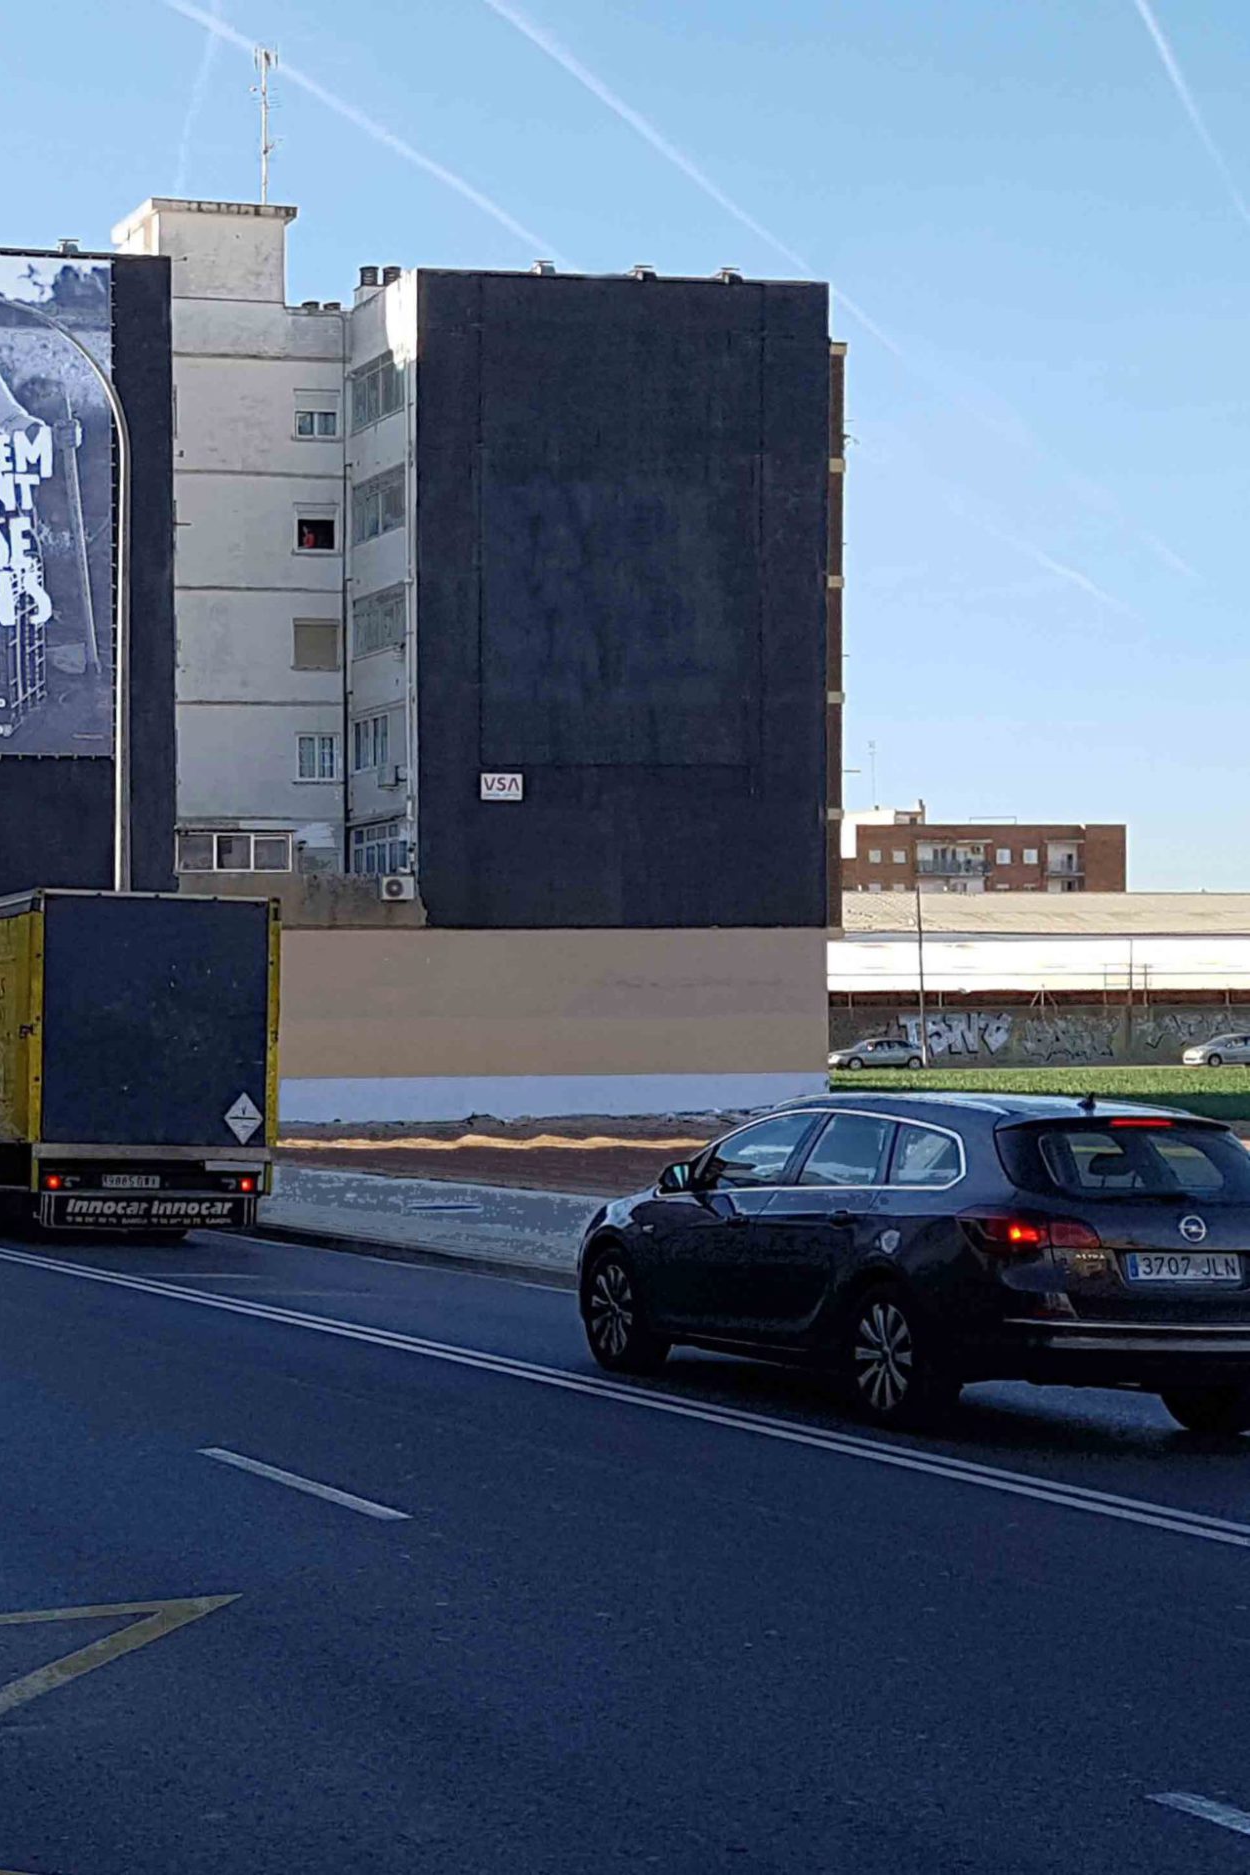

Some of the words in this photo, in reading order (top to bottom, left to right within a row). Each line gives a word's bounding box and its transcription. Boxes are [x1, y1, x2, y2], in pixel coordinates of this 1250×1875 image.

[483, 776, 520, 792] VSA
[1141, 1256, 1191, 1276] 3707
[1201, 1257, 1238, 1278] JLN
